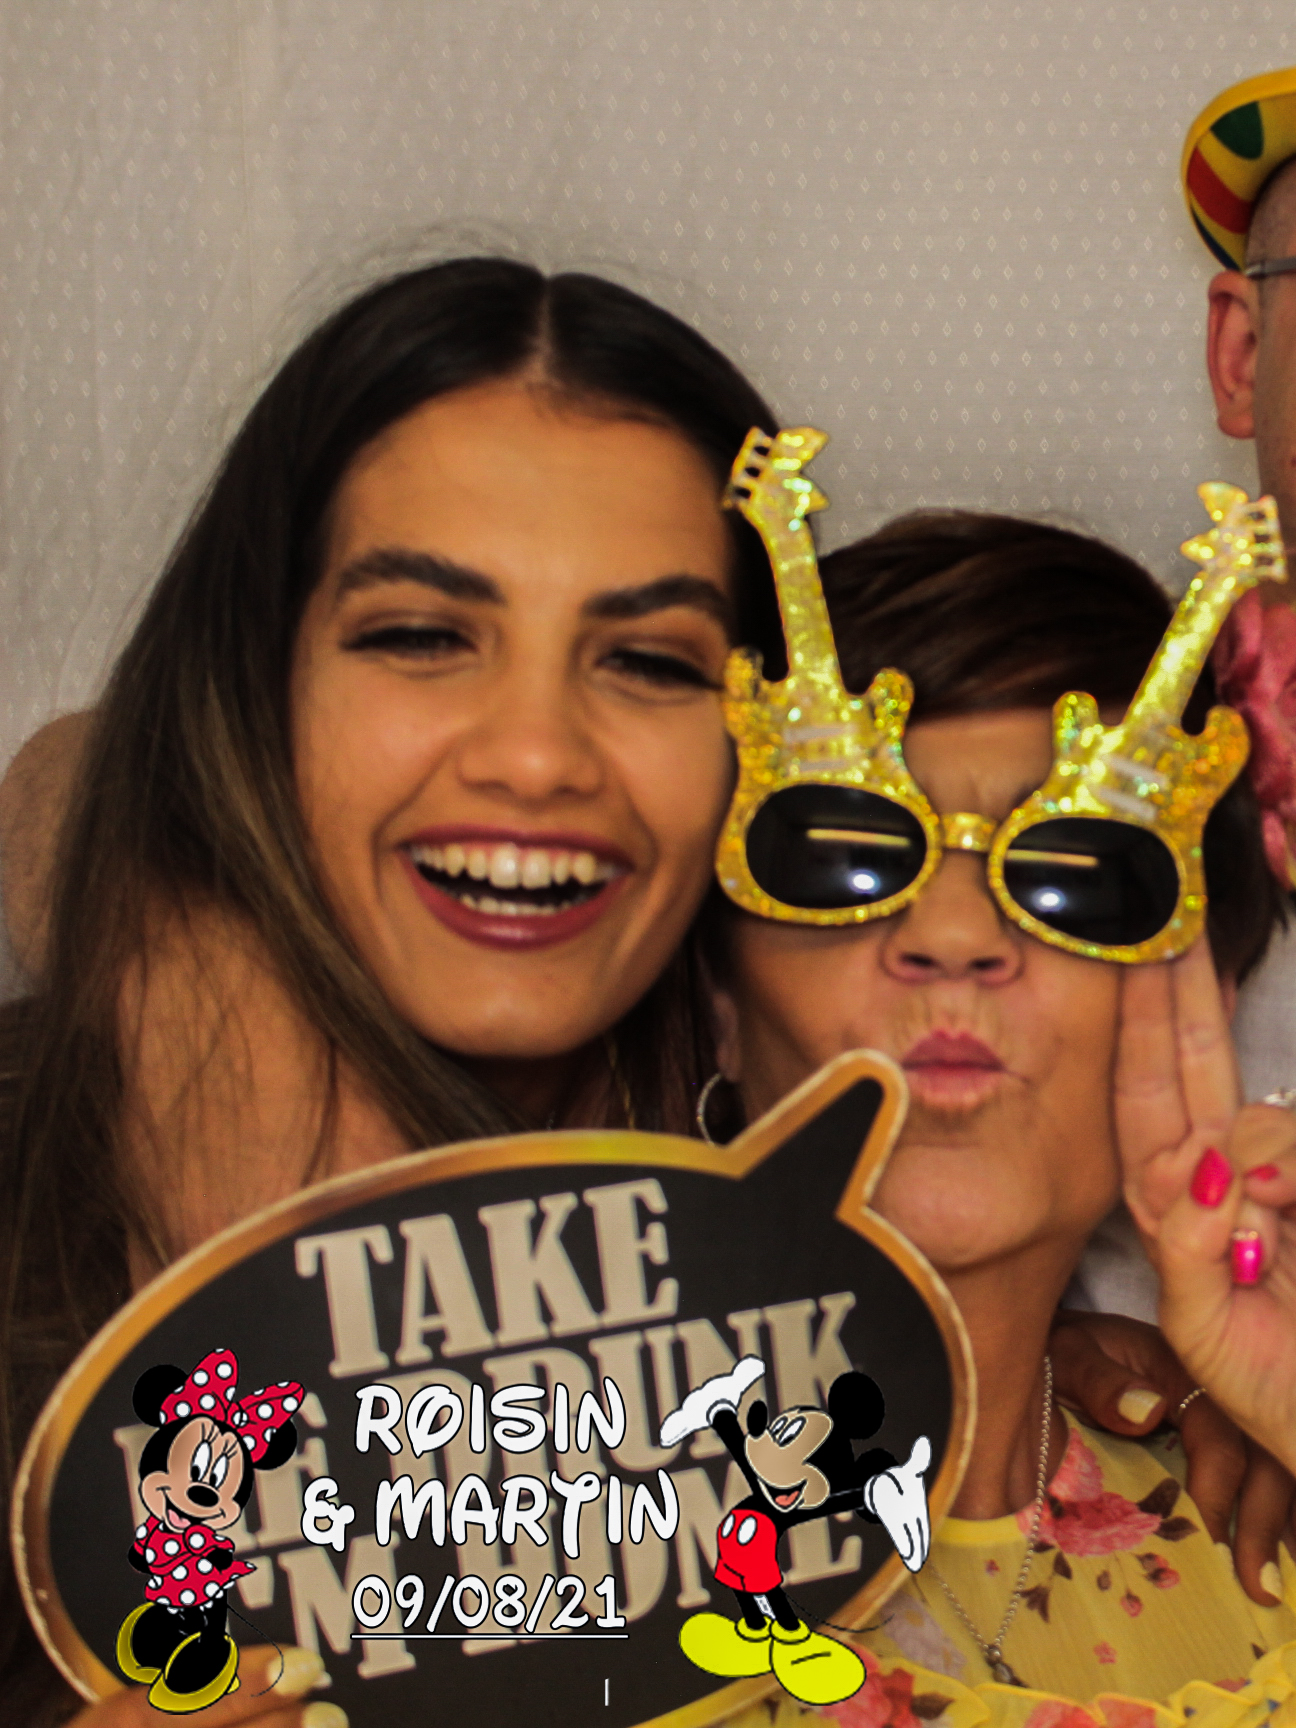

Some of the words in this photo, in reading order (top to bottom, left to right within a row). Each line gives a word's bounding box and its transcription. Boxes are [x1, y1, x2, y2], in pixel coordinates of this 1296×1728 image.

[295, 1178, 679, 1379] TAKE
[113, 1391, 340, 1553] E
[226, 1530, 416, 1689] 'M
